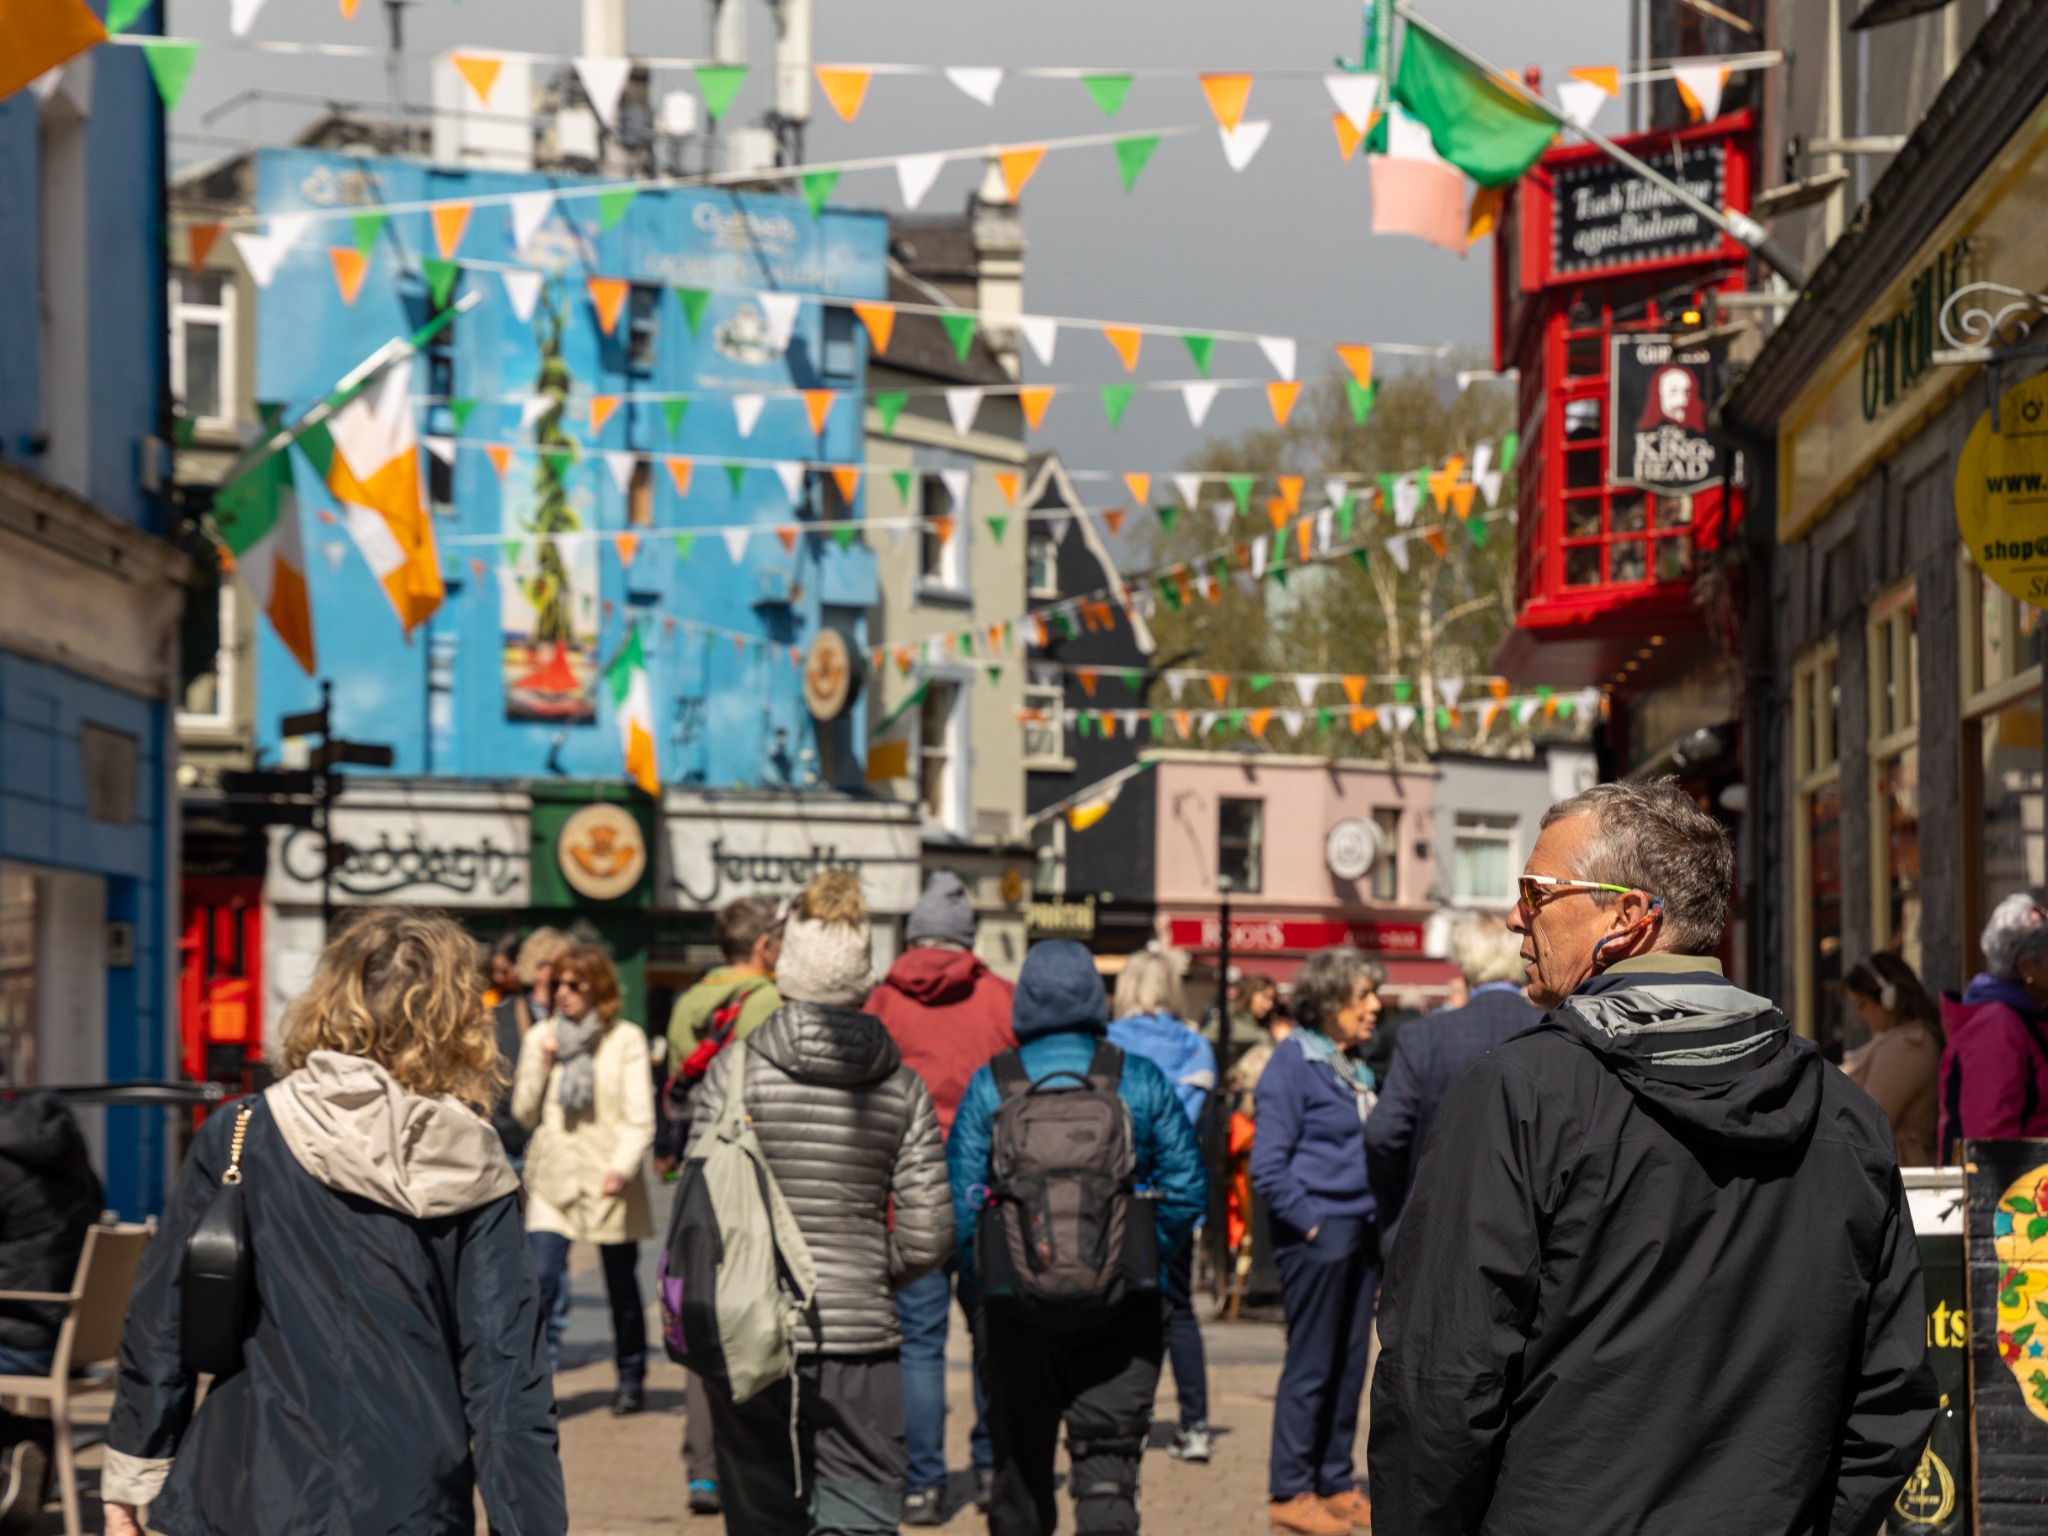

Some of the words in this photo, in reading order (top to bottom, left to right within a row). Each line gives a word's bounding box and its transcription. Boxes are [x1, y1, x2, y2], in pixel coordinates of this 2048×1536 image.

[1633, 460, 1710, 481] HEAD
[282, 829, 519, 896] Caddagh
[1926, 1300, 1969, 1348] ts
